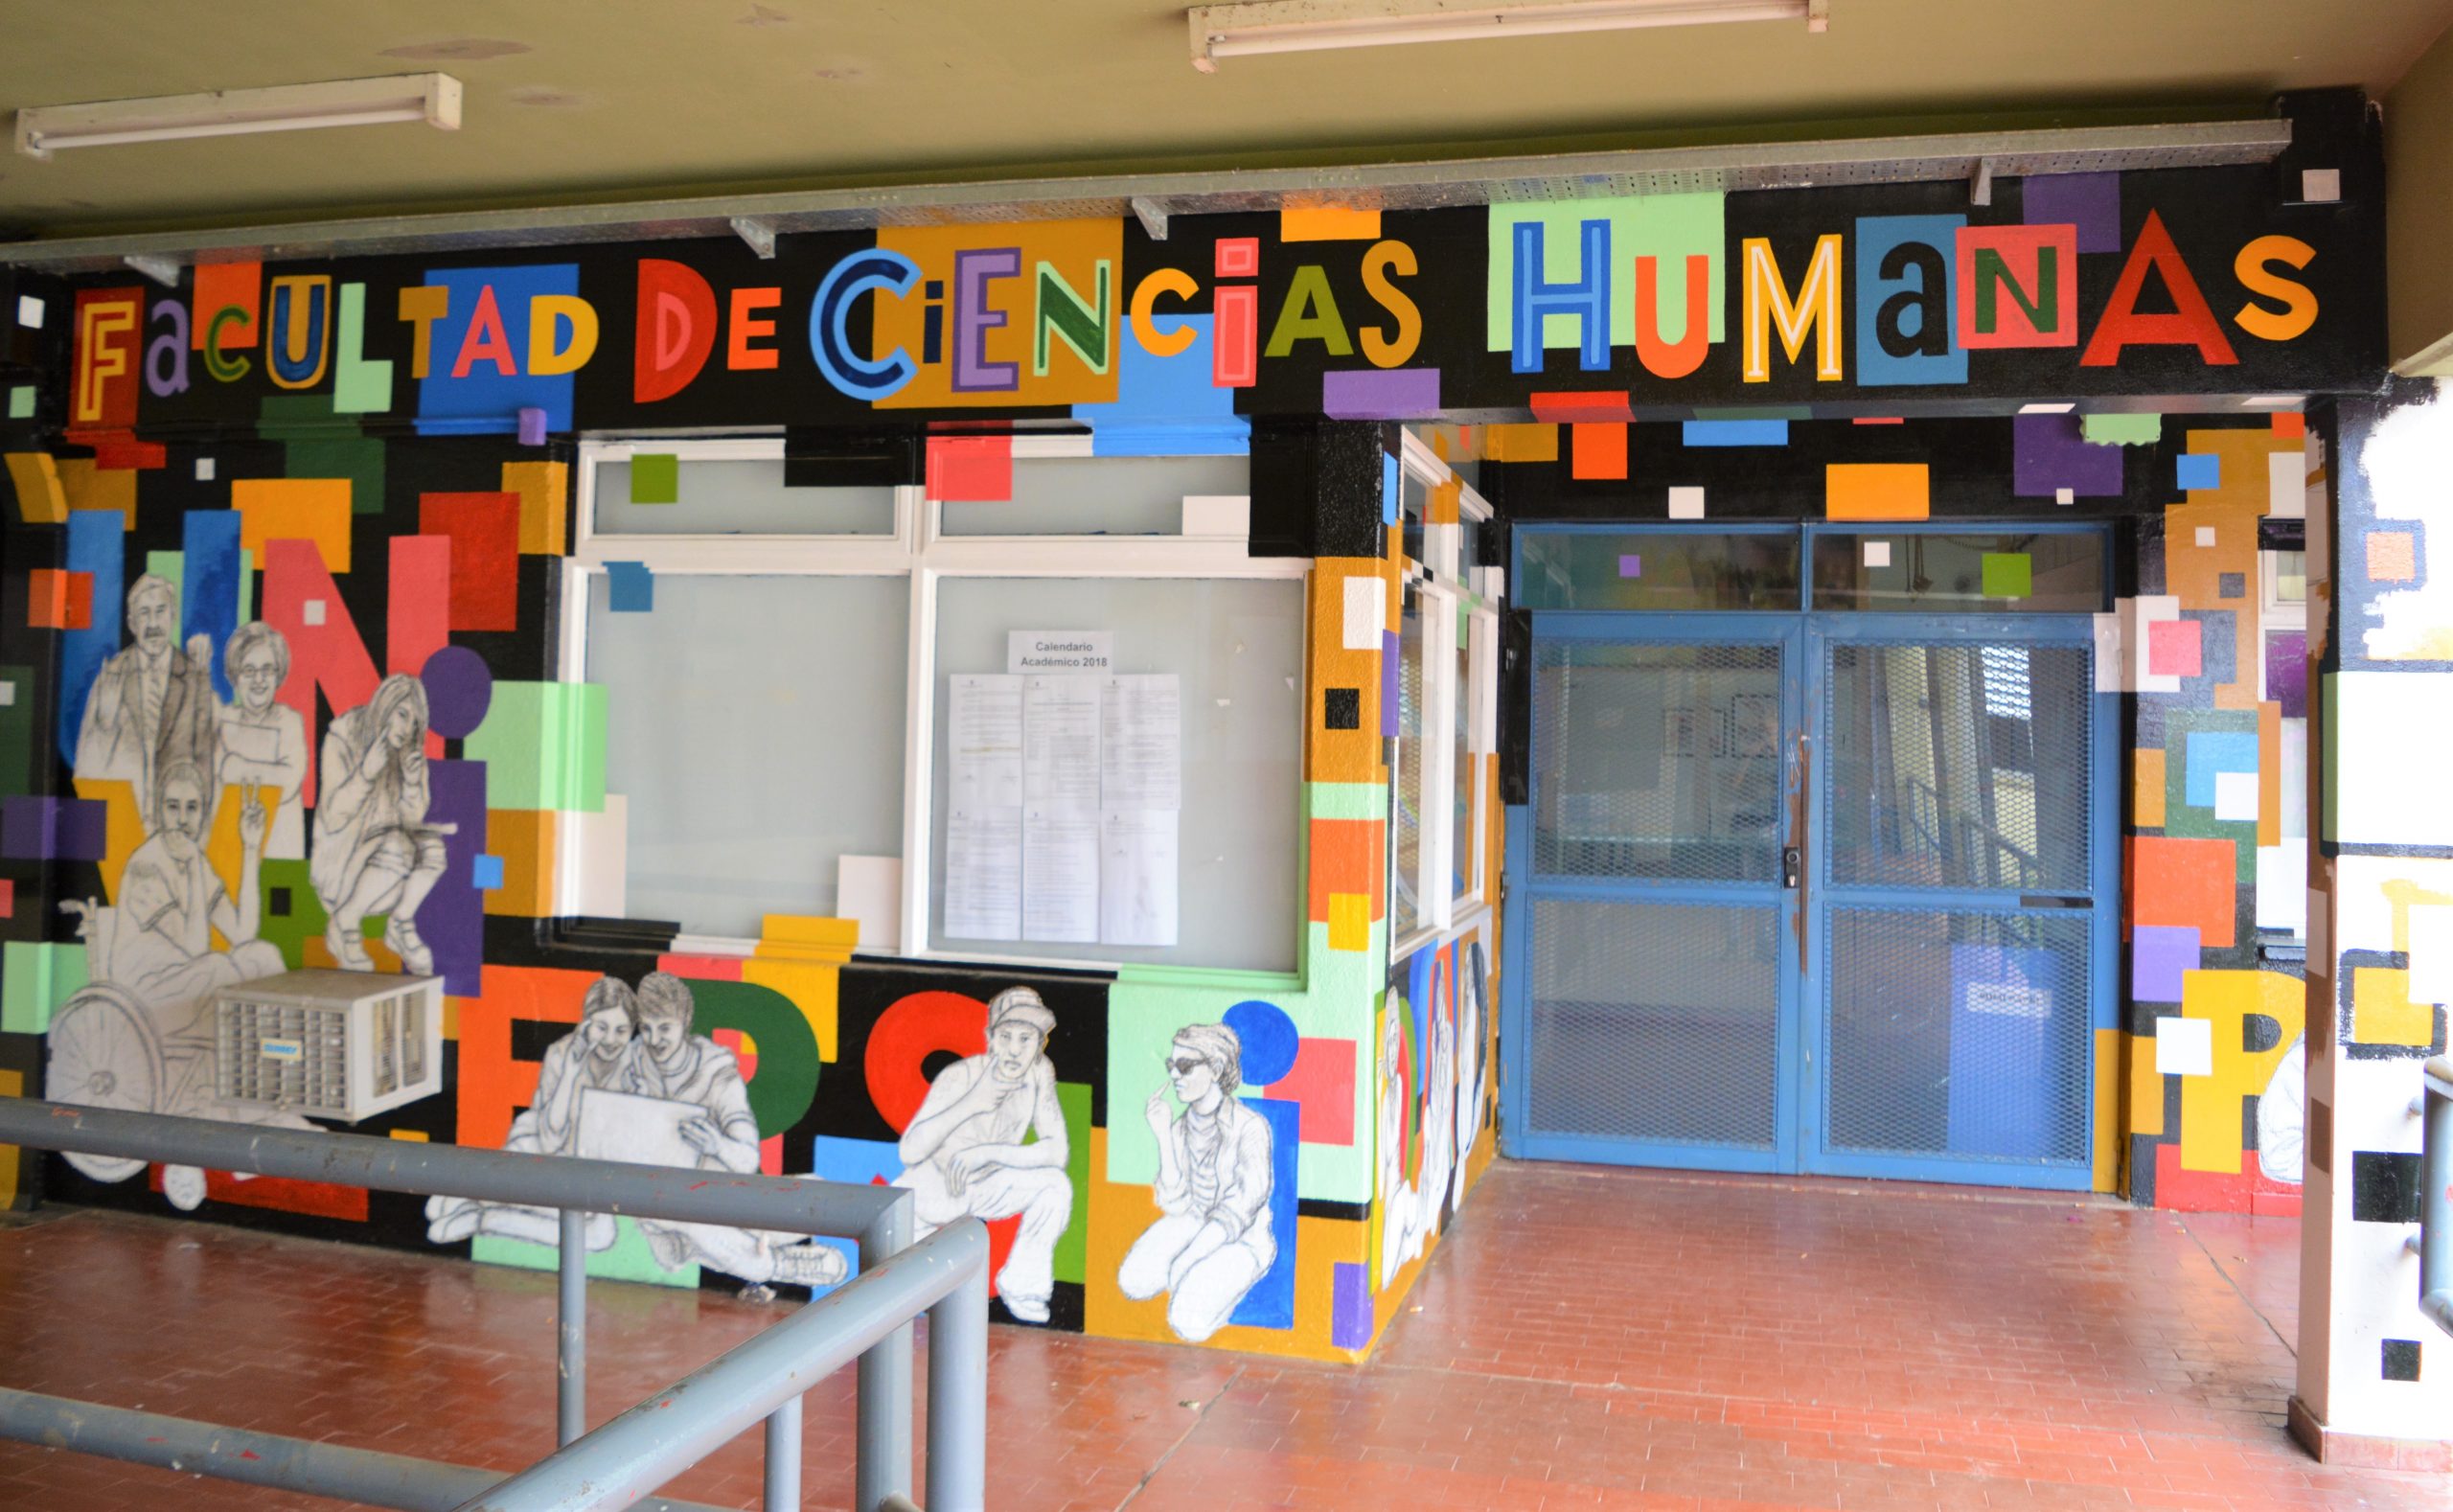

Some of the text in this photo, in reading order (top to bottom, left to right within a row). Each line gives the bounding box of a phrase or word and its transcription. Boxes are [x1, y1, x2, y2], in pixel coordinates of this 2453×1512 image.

[633, 257, 782, 404] DE
[1035, 641, 1093, 652] Calendario
[1020, 656, 1108, 667] Académico 2018
